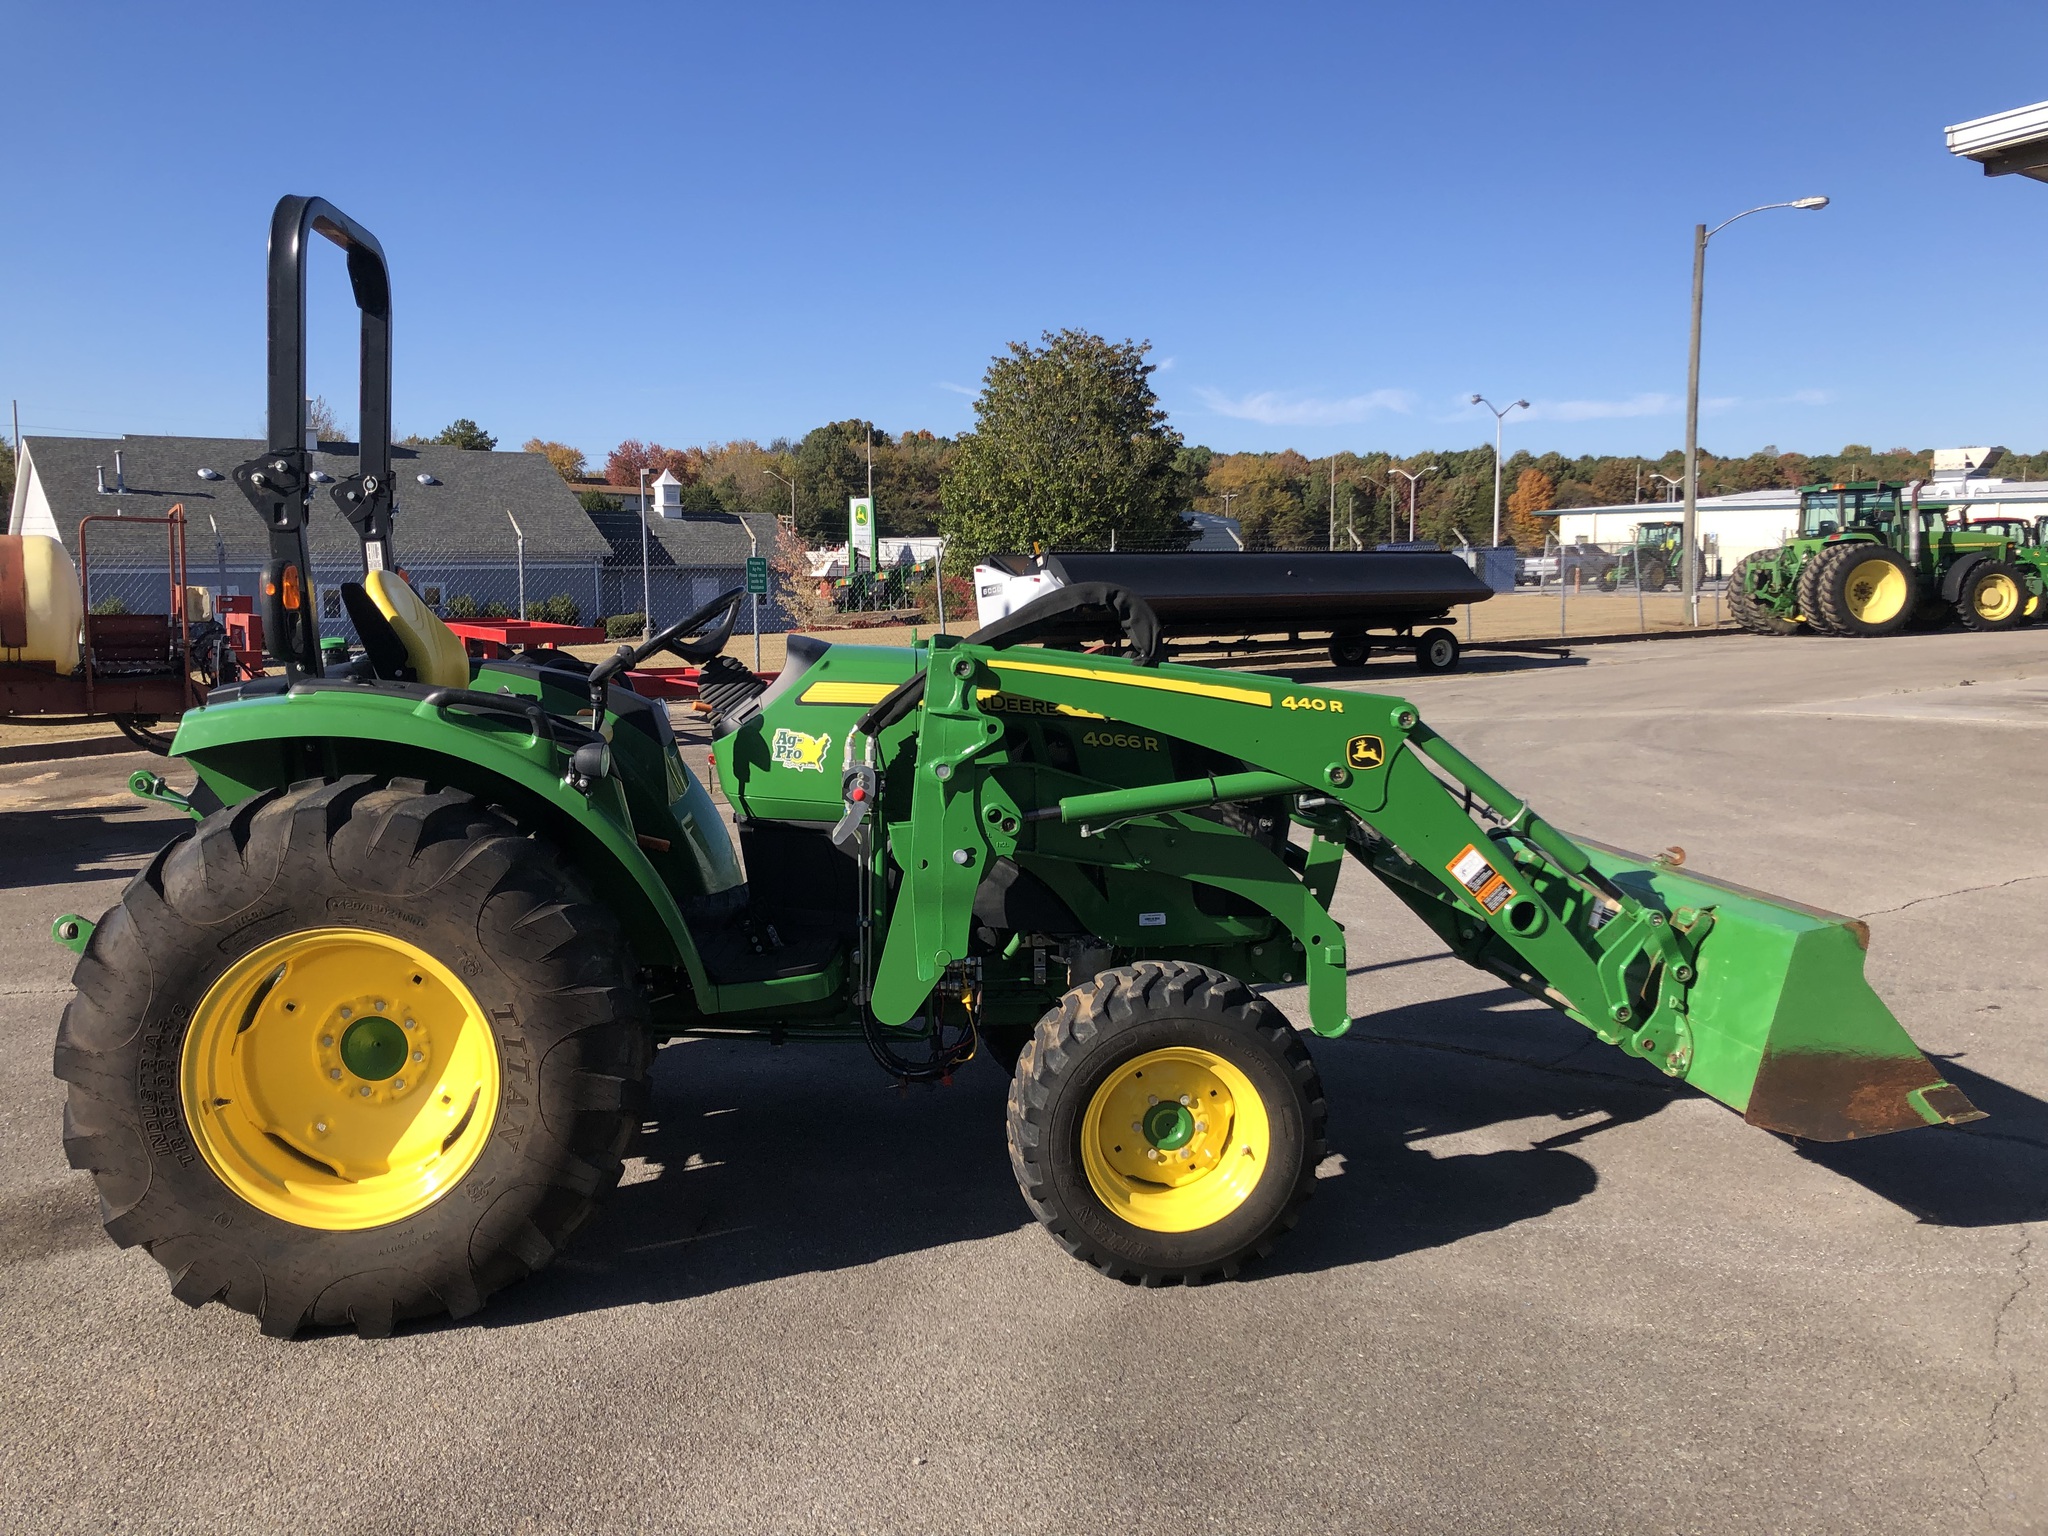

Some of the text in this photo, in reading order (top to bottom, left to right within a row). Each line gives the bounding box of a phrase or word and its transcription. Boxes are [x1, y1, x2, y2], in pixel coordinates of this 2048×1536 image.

[991, 695, 1059, 715] DEERE
[775, 745, 802, 759] Pro
[490, 1003, 532, 1154] TITAN
[155, 1059, 195, 1168] TRACTOR
